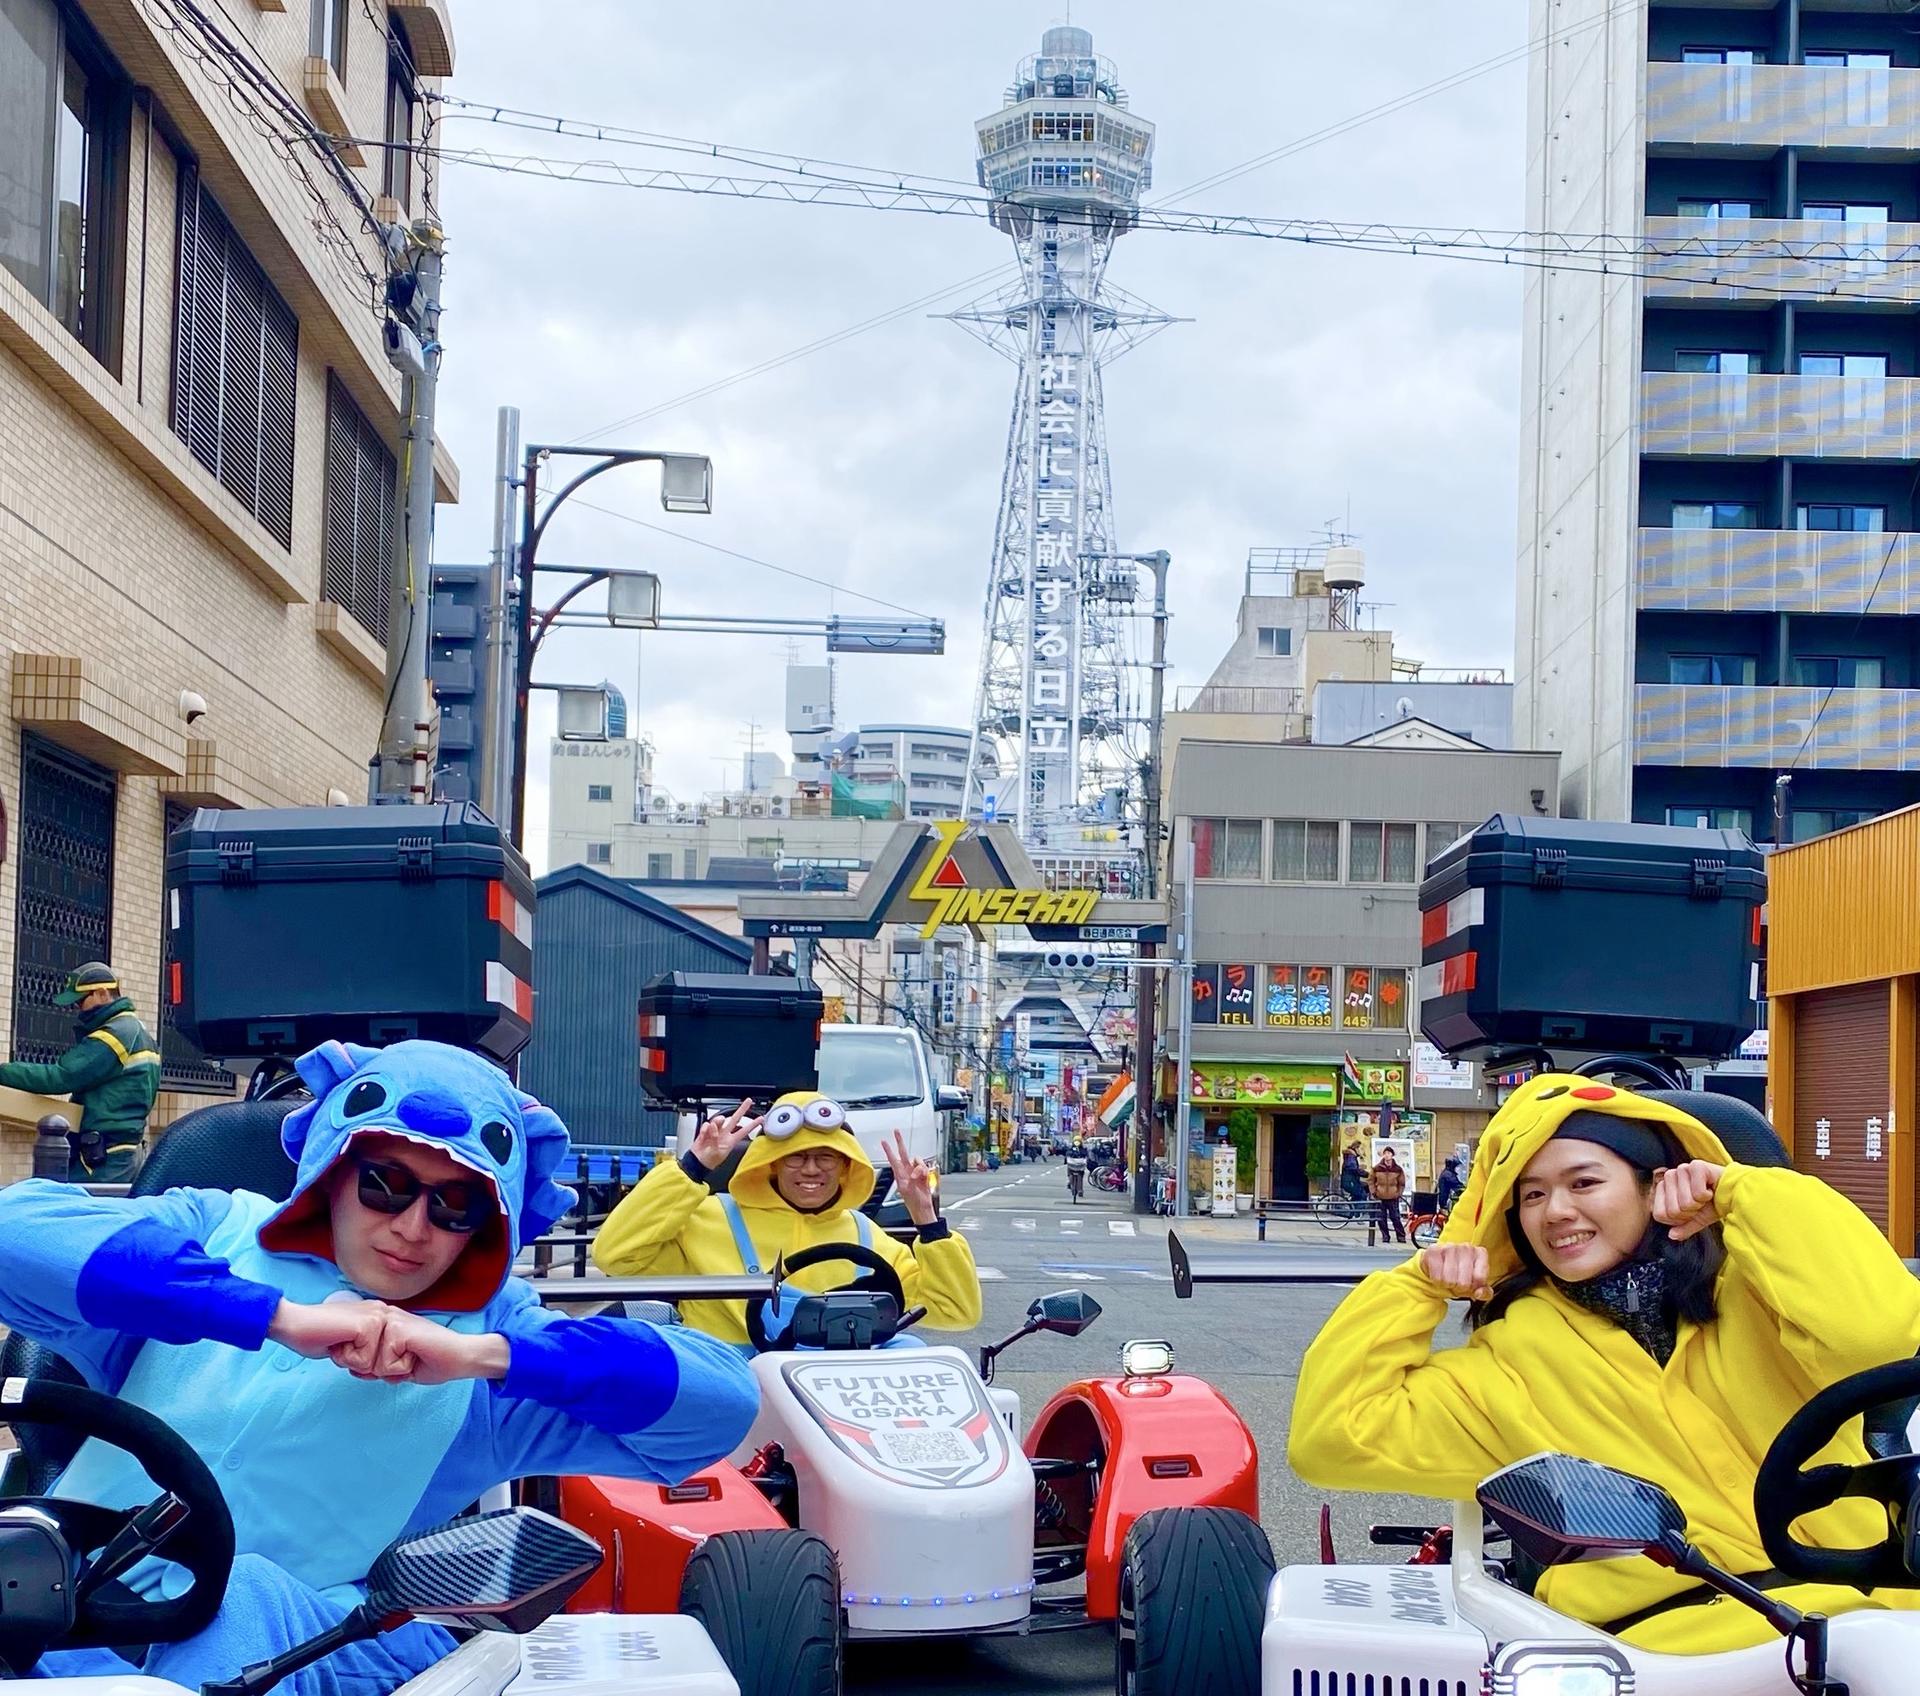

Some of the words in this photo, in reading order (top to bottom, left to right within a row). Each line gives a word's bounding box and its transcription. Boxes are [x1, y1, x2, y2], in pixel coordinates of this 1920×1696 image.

[1033, 354, 1077, 754] 社会に貢献する日立
[1221, 1012, 1251, 1025] TEL
[1269, 1015, 1296, 1025] (06)
[1299, 1015, 1332, 1026] 6633
[812, 1372, 959, 1391] FUTURE
[838, 1389, 947, 1407] KART
[851, 1405, 957, 1419] OSAKA
